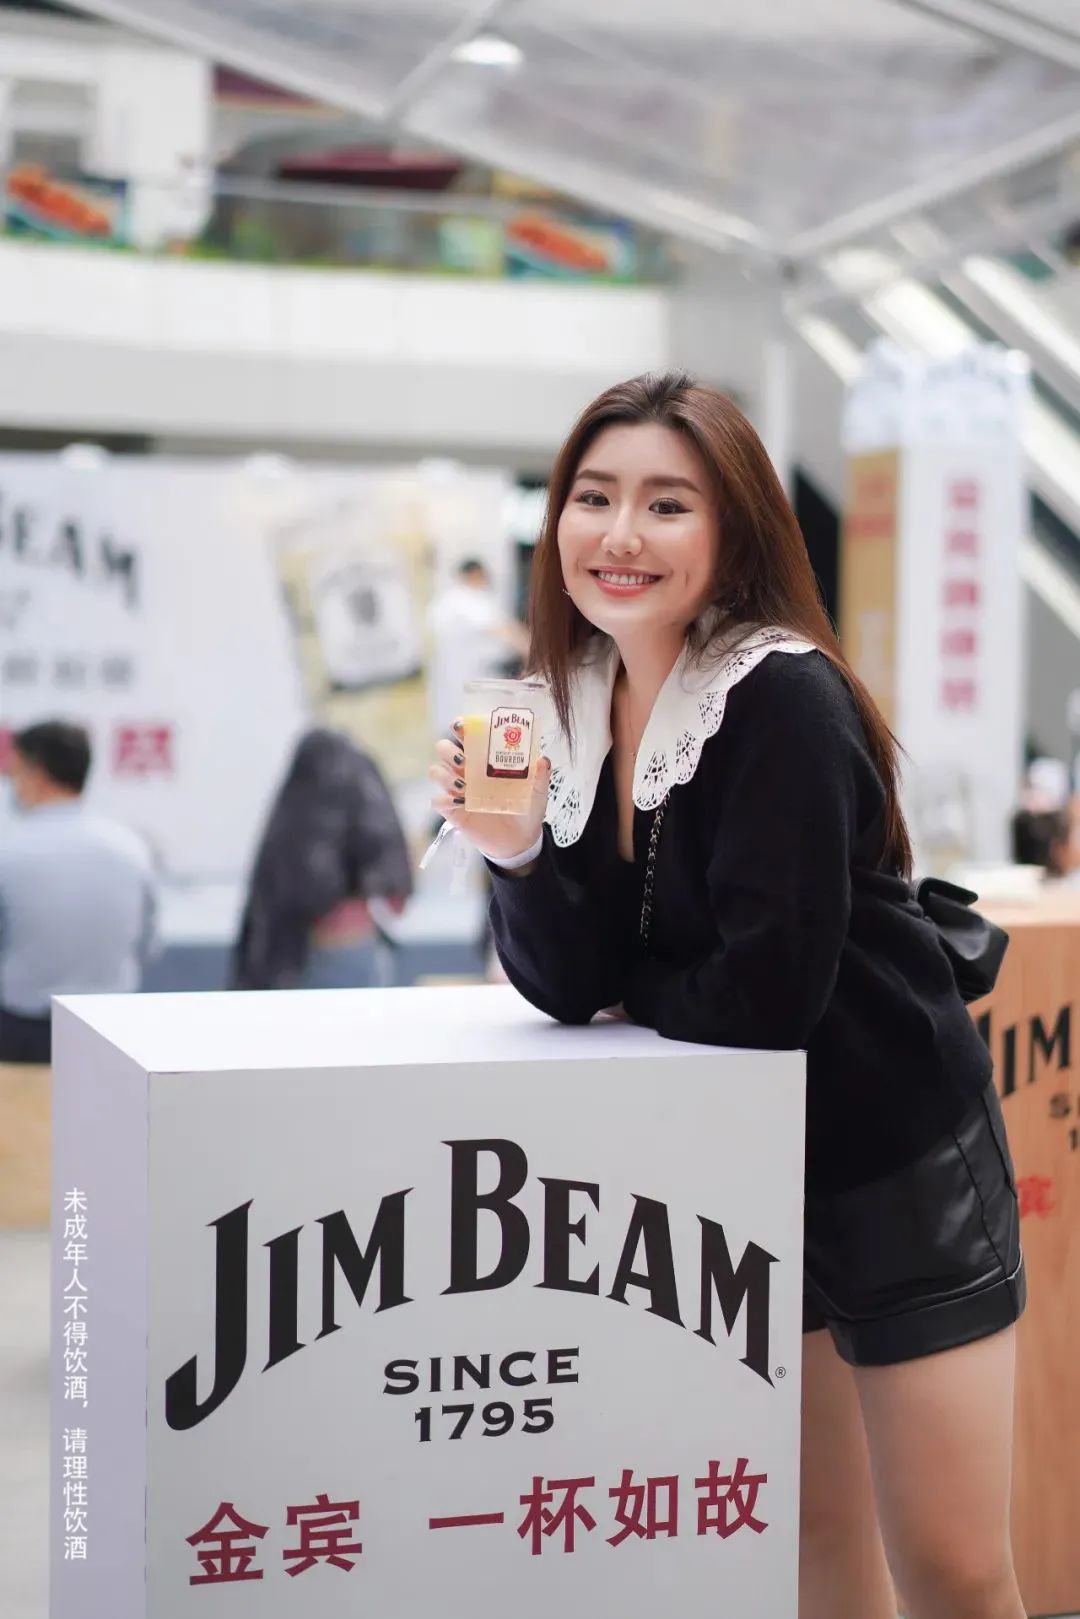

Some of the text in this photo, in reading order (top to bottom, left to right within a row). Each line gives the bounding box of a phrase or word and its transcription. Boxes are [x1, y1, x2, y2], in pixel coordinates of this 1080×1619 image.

[494, 713, 530, 730] JIM BEAM
[164, 1138, 781, 1432] JIM BEAM
[382, 1346, 580, 1396] SINCE
[414, 1396, 555, 1443] 1795
[187, 1457, 769, 1585] 金宾 一杯如故
